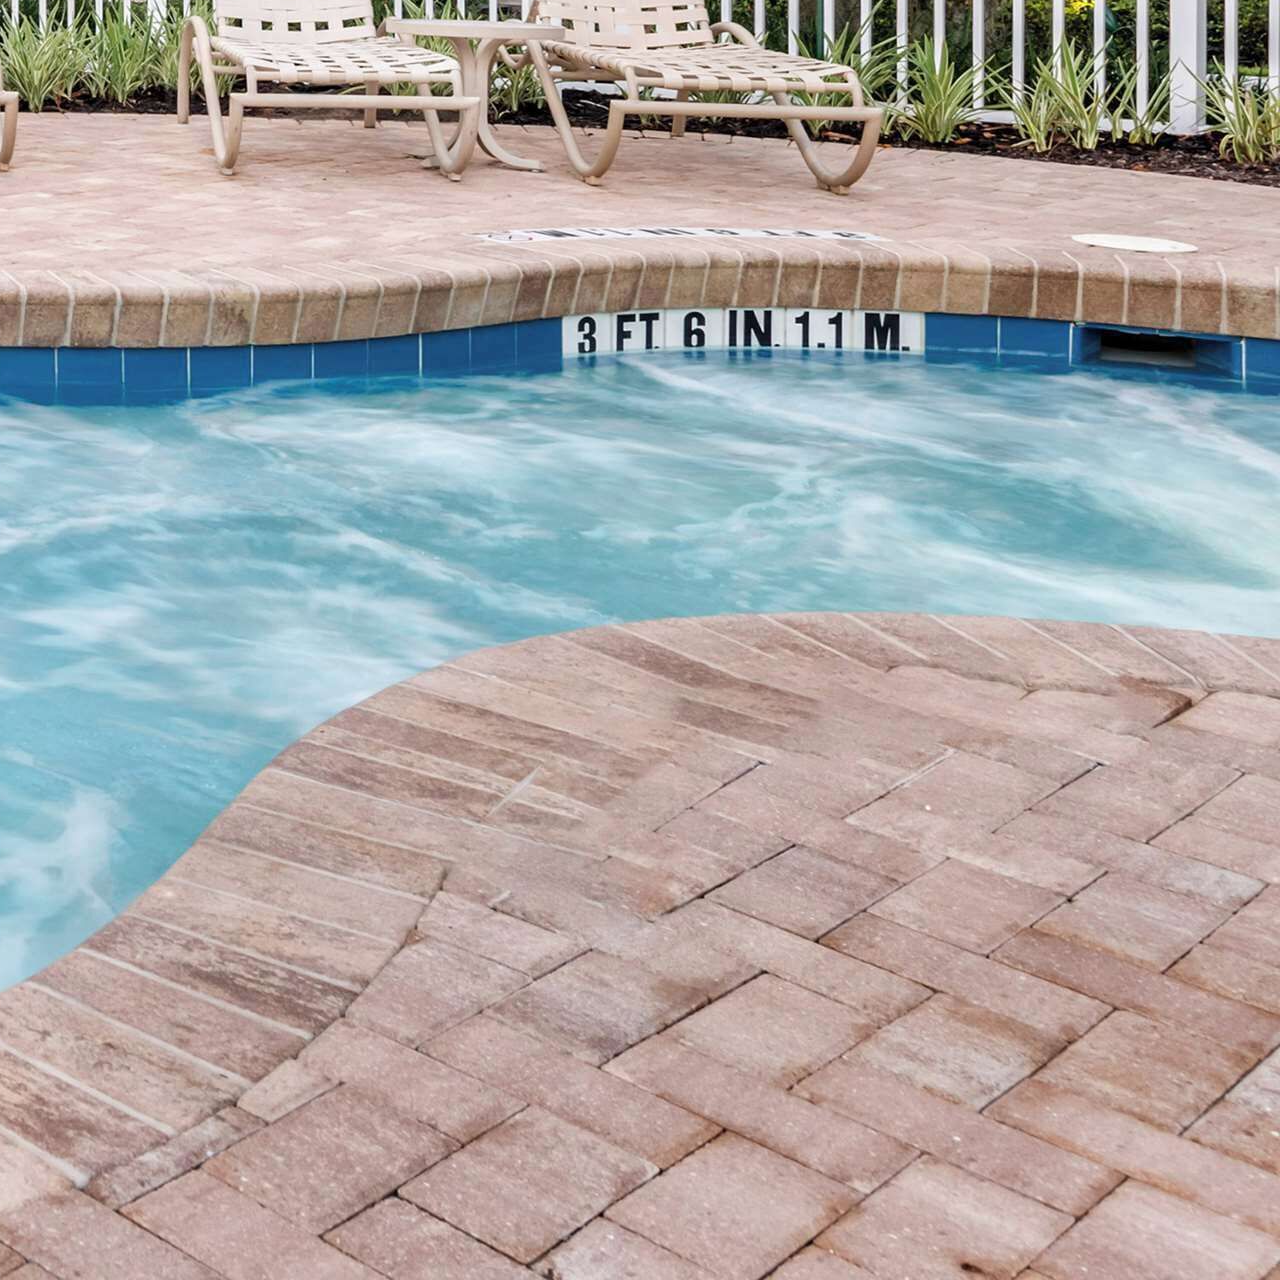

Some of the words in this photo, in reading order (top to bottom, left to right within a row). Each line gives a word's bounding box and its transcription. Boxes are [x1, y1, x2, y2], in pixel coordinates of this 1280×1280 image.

[577, 316, 597, 354] 3
[616, 312, 661, 352] FT.
[683, 311, 707, 348] 6
[728, 310, 781, 348] IN.
[794, 311, 844, 350] 1.1
[863, 312, 911, 352] M.
